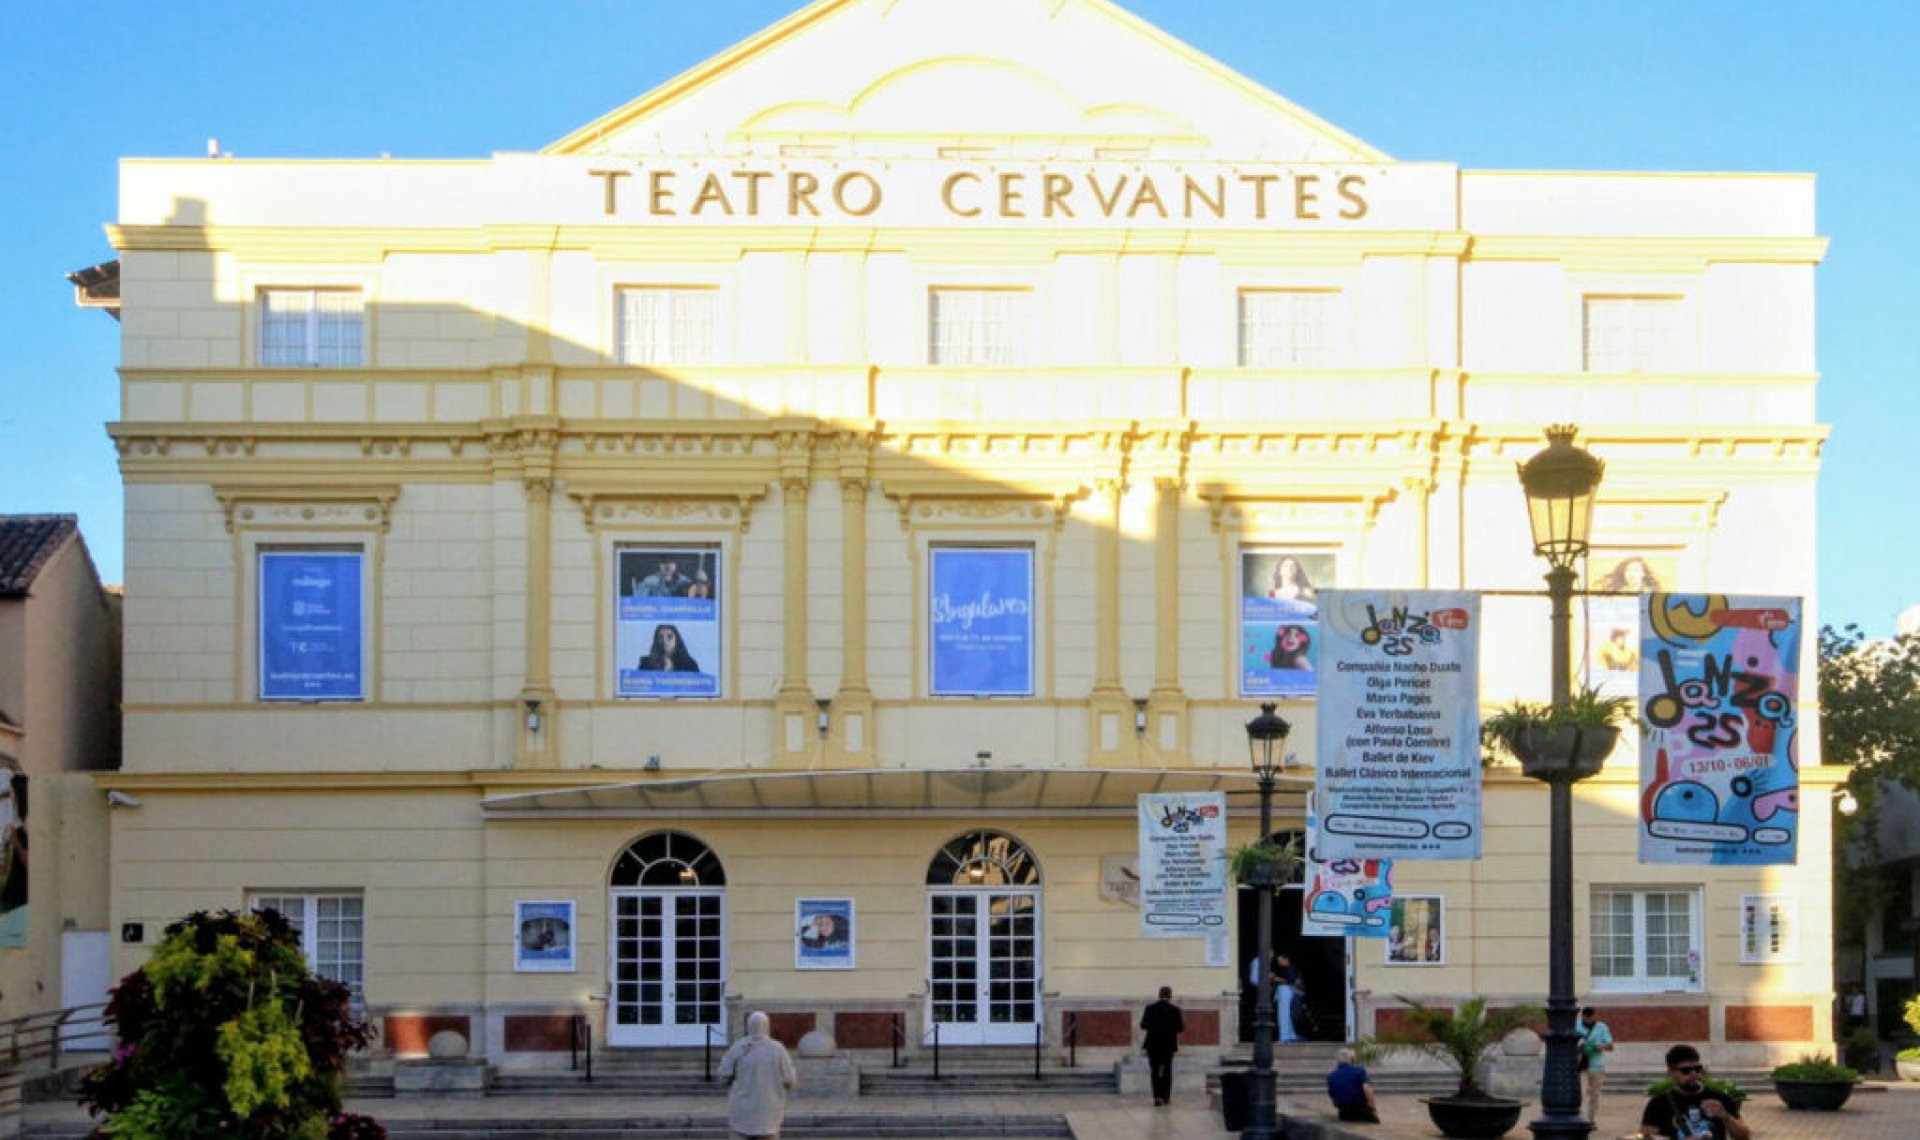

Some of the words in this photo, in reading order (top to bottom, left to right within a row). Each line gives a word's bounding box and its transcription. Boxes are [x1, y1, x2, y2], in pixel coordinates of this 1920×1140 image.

[588, 169, 883, 216] TEATRO
[942, 171, 1368, 220] CERVANTES
[1393, 661, 1427, 672] Nacho
[1366, 677, 1391, 689] Olga
[1356, 707, 1375, 719] Eva
[1372, 736, 1403, 747] Paula
[1362, 752, 1393, 762] Ballet
[1396, 752, 1408, 762] de
[1411, 752, 1435, 763] Kiev
[1325, 767, 1356, 778] Ballet
[1400, 767, 1470, 778] Internacional
